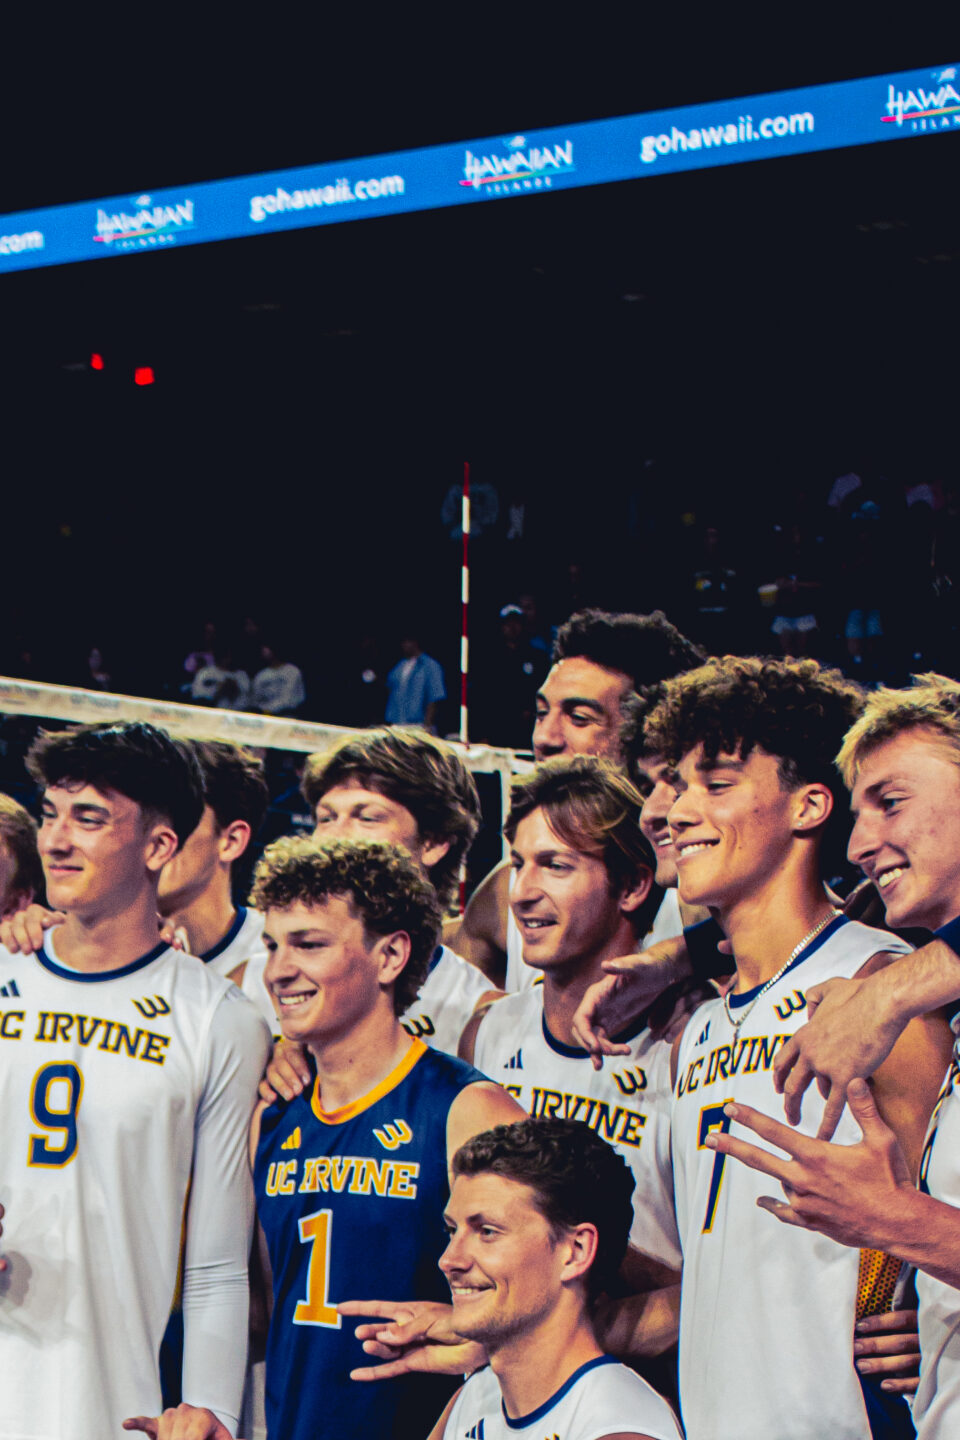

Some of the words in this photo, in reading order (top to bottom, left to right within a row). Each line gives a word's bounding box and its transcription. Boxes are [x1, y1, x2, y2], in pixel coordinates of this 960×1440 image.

[640, 111, 814, 162] gohawaii.com
[464, 140, 572, 190] HAWAIIAN
[250, 173, 404, 222] gohawaii.com
[34, 1011, 170, 1066] IRVINE
[27, 1060, 84, 1168] 9
[530, 1086, 647, 1149] IRVINE
[266, 1159, 297, 1197] UC
[298, 1155, 420, 1199] IRVINE
[697, 1097, 735, 1235] 7
[292, 1208, 341, 1329] 1
